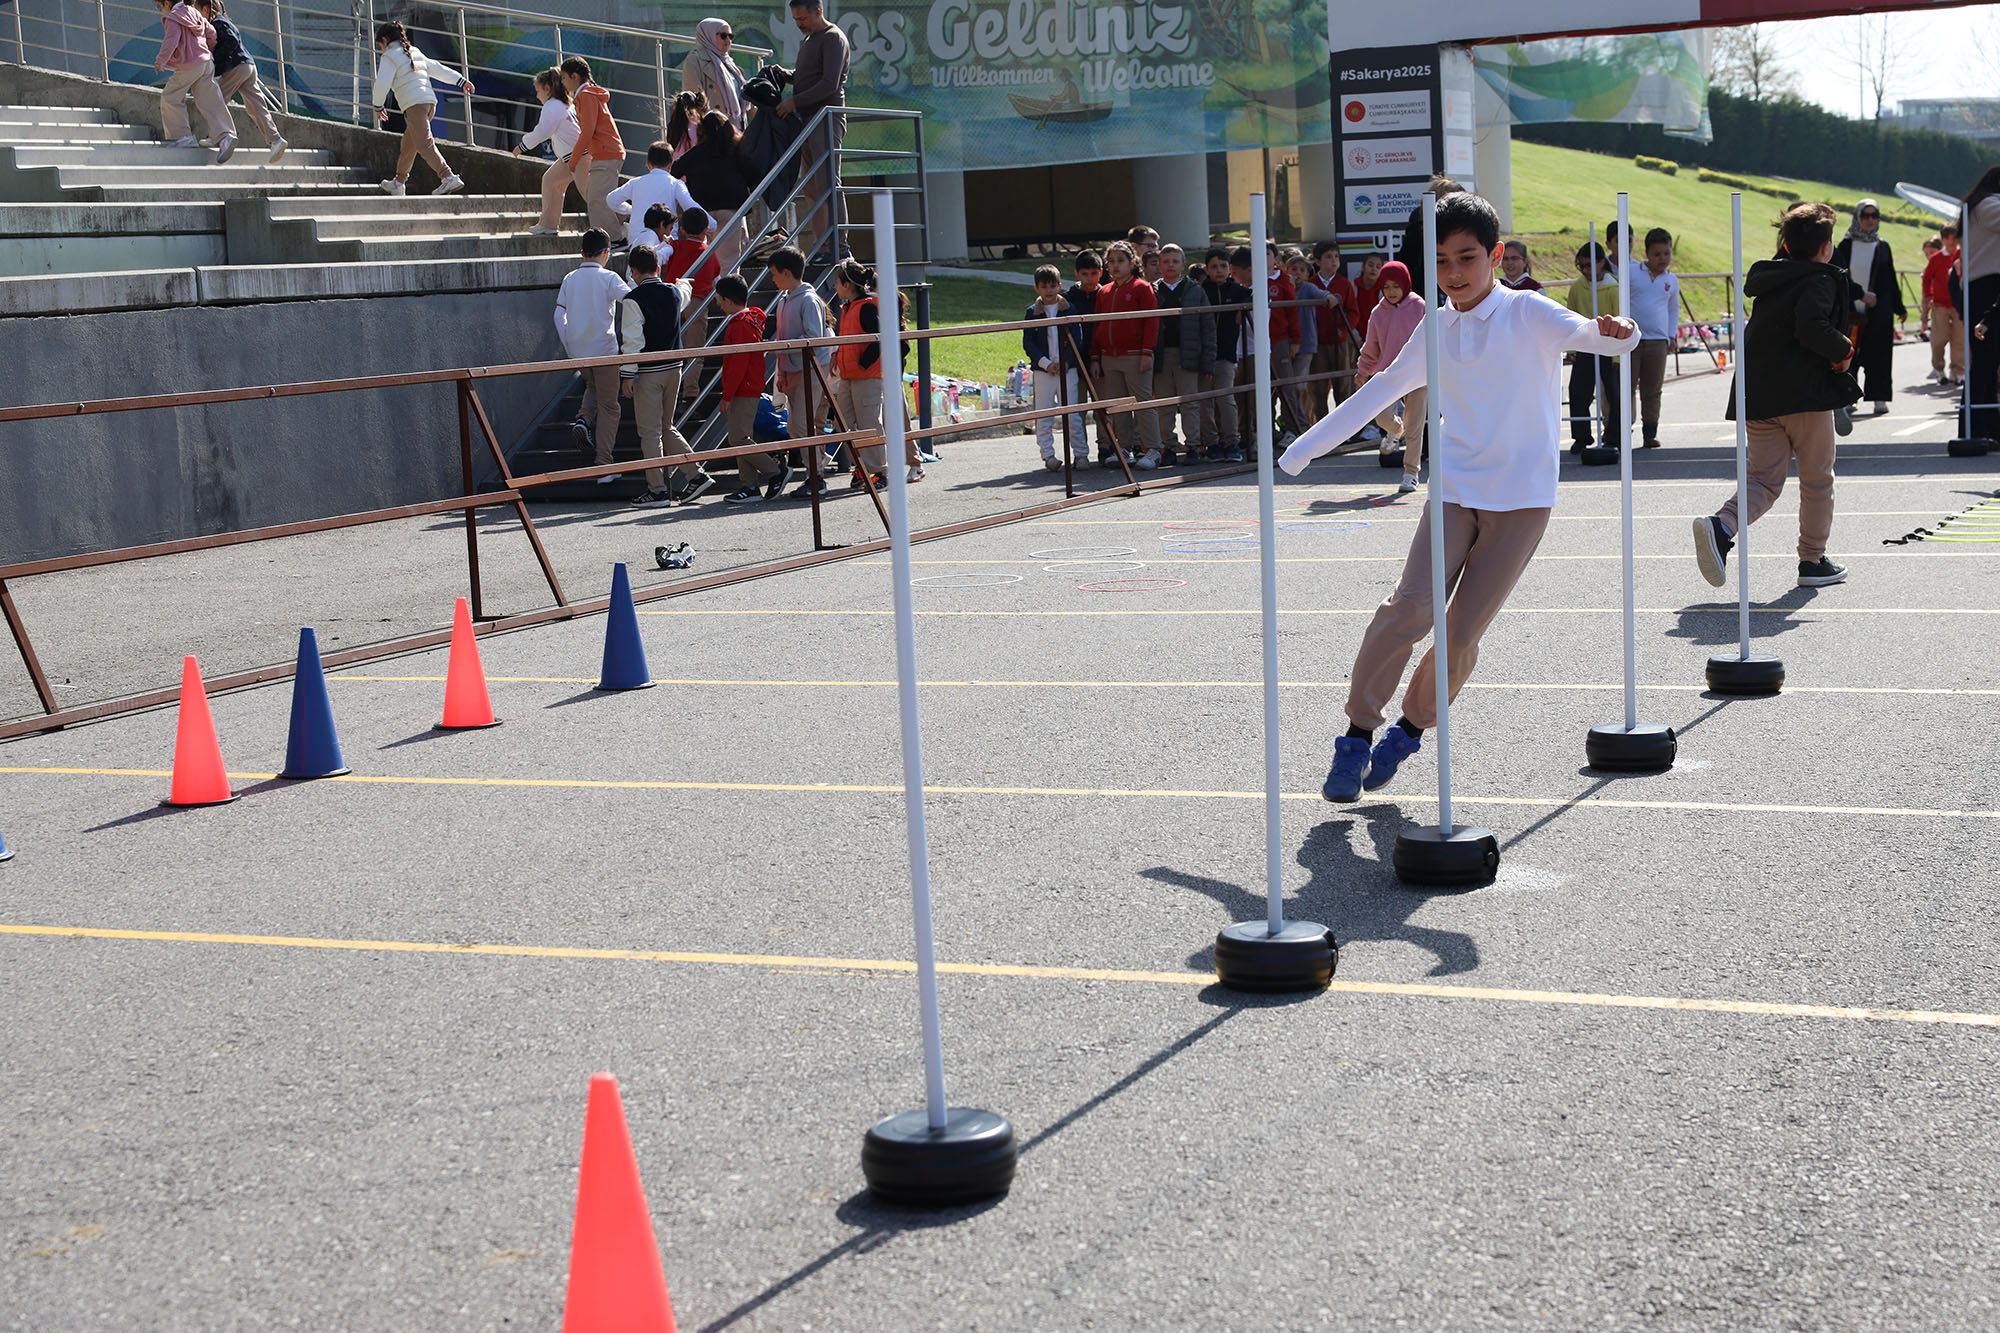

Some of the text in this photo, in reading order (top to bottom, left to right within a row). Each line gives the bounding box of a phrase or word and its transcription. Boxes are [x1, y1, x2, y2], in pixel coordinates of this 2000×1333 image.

[927, 0, 1189, 60] Geldiniz
[930, 64, 1055, 88] Willkommen
[1080, 59, 1216, 93] Welcome
[1340, 65, 1431, 81] #Sakarya2025
[1377, 199, 1420, 207] BÜYÜKŞEHİ
